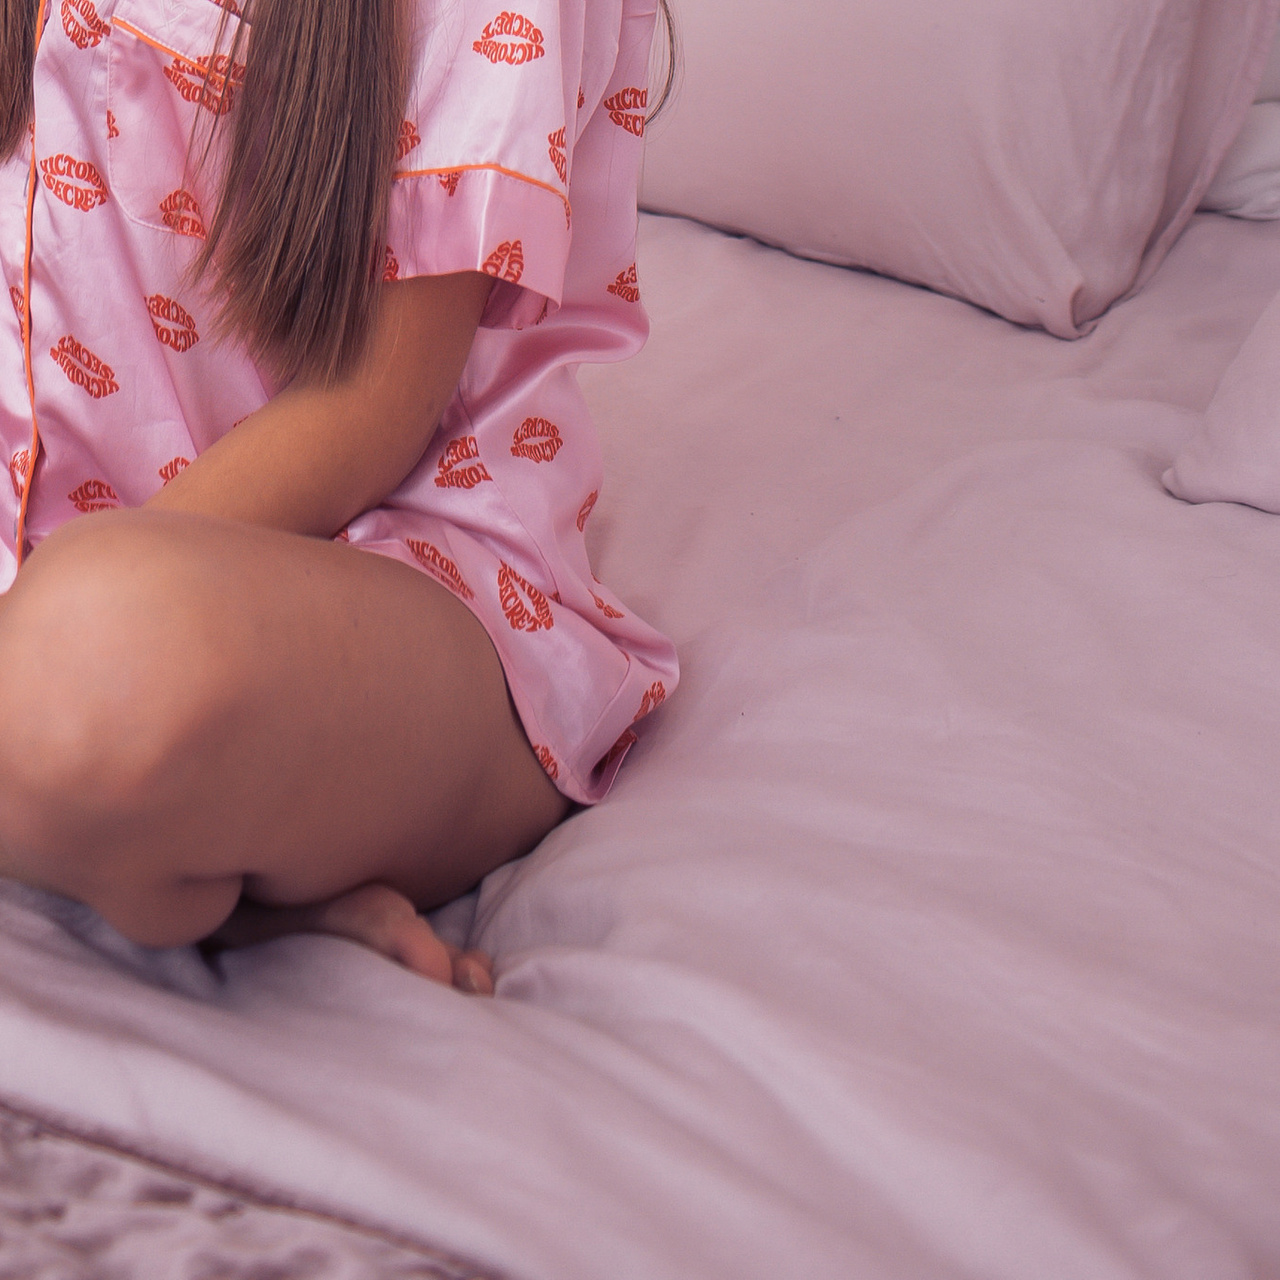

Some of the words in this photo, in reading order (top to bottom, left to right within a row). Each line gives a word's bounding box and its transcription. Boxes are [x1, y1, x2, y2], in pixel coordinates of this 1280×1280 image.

[61, 0, 104, 50] SECRET
[482, 10, 545, 45] SECRET
[472, 39, 546, 66] VICTORIA'S
[609, 111, 645, 138] SEC
[43, 173, 108, 213] SECRET
[482, 240, 512, 279] SEC
[144, 294, 197, 331] SECRE
[513, 417, 560, 446] SECRET
[498, 567, 544, 633] SECRET
